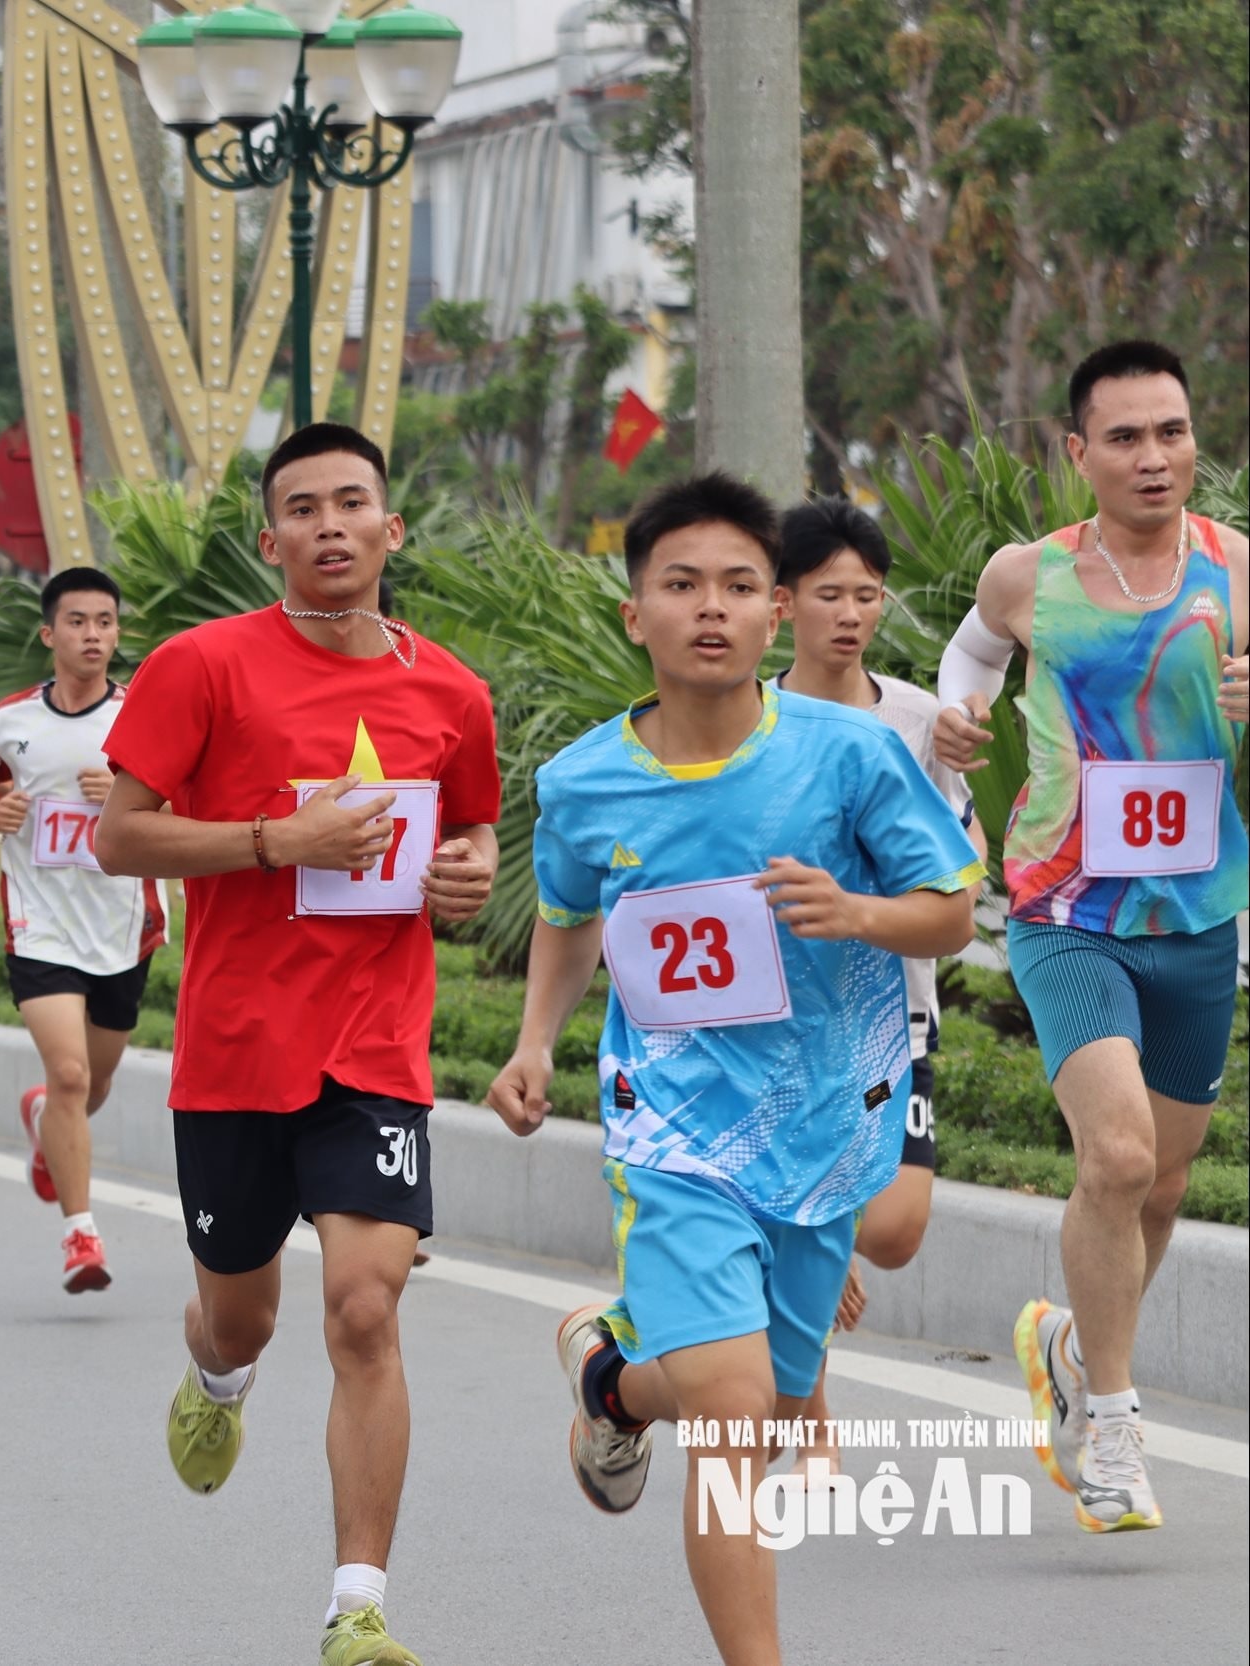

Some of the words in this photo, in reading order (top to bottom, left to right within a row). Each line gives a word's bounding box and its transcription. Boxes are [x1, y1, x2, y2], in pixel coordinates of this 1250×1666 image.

[350, 817, 408, 881] 7
[1122, 790, 1186, 848] 89
[651, 916, 735, 994] 23
[376, 1126, 418, 1187] 30
